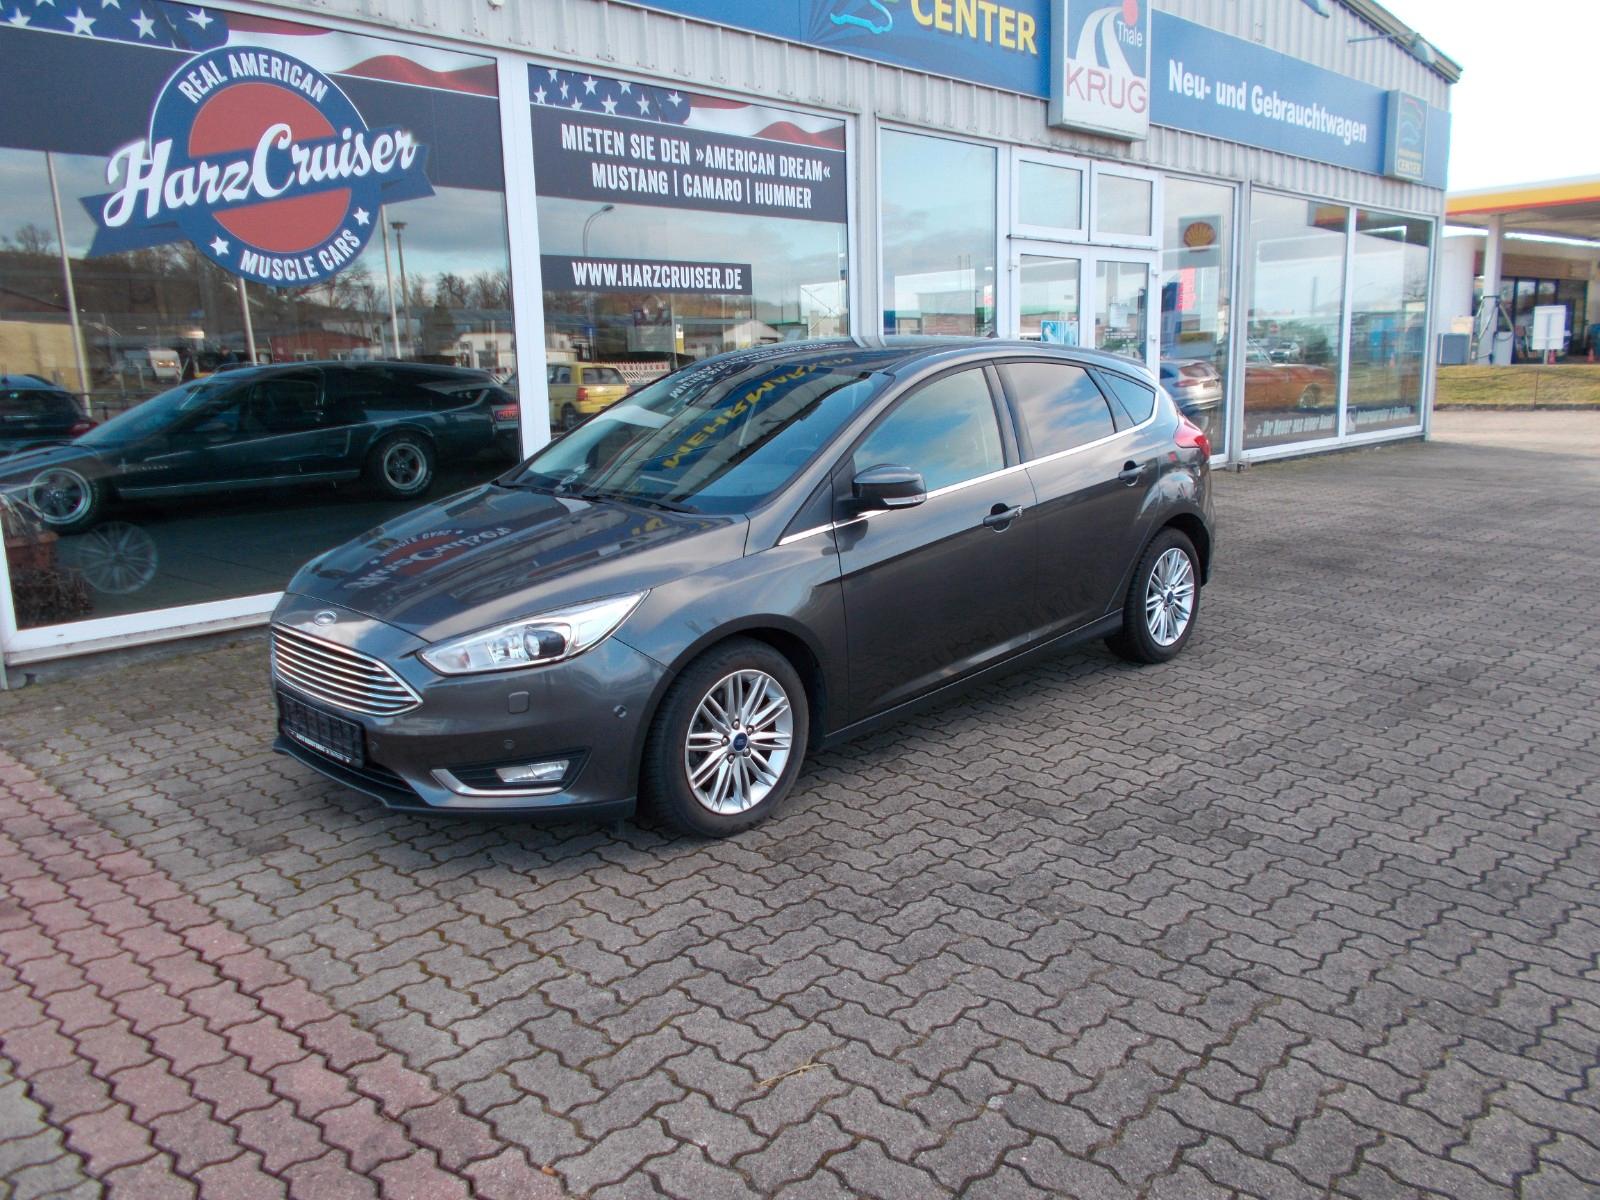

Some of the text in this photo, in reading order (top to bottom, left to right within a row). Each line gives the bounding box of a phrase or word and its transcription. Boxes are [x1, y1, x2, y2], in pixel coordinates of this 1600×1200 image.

[910, 0, 1037, 54] CENTER
[1116, 20, 1144, 48] Thale
[178, 53, 328, 103] REAL AMERICAN
[1066, 61, 1147, 114] KRUG
[1168, 59, 1367, 146] Neu- und Gebrauchtwagen
[561, 123, 625, 157] MIETEN
[630, 133, 656, 161] SIE
[660, 137, 691, 165] DEN
[103, 123, 417, 228] HarzCruiser
[592, 162, 669, 195] MUSTANG
[682, 177, 743, 203] CAMARO
[755, 186, 812, 210] HUMMER
[239, 228, 361, 282] MUSCLE CARS
[571, 261, 743, 291] WWW.HARZCRUISER.DE
